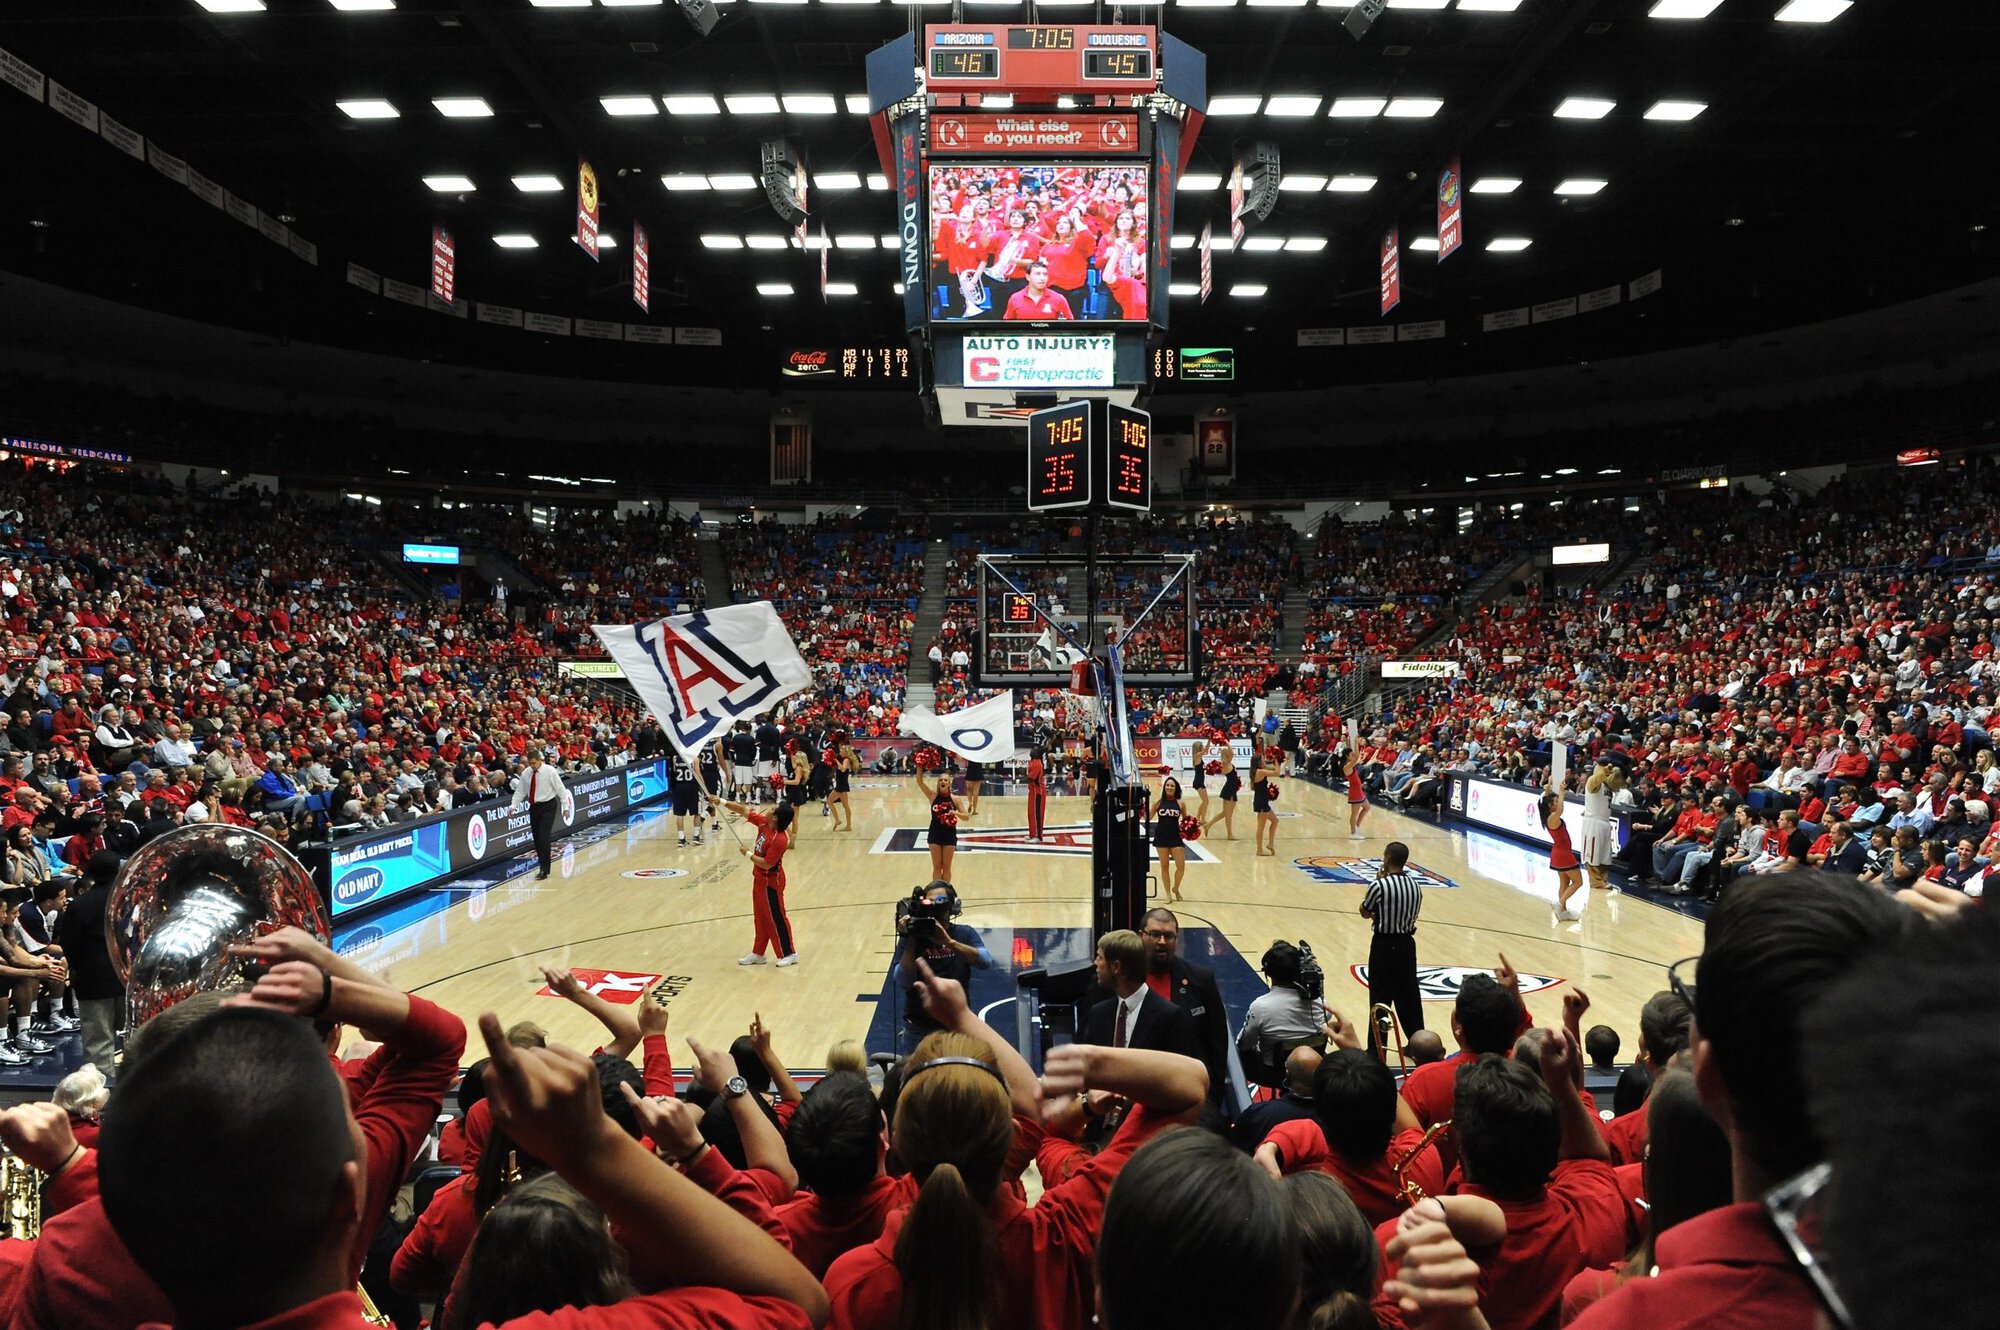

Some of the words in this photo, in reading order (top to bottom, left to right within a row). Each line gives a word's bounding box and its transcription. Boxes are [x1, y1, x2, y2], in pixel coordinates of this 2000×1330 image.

[944, 33, 985, 45] ARIZONA
[1026, 28, 1073, 48] 7:05
[1092, 34, 1144, 46] DUQUESNE
[954, 53, 982, 73] 46
[1108, 54, 1135, 74] 45
[996, 118, 1035, 132] What
[1039, 119, 1070, 132] else
[983, 131, 1003, 145] do
[1006, 133, 1033, 147] you
[1036, 131, 1083, 145] need?
[903, 201, 919, 285] DOWN
[966, 338, 1020, 350] AUTO
[1027, 338, 1111, 350] INJURY?
[1006, 357, 1036, 366] FIRST
[1004, 367, 1104, 382] Chiropractic
[1046, 416, 1083, 445] 7:05
[1121, 419, 1147, 448] 7:05
[12, 439, 64, 454] ARIZONA
[71, 447, 123, 462] WILDCATS
[1208, 443, 1223, 454] 22
[1042, 453, 1075, 494] 35
[1118, 454, 1142, 494] 35
[1011, 606, 1029, 619] 35
[574, 664, 617, 673] SUNSTREET
[1401, 662, 1446, 673] Fidelity
[700, 752, 713, 764] 22
[676, 769, 693, 781] 20
[486, 809, 497, 822] THE
[1158, 808, 1180, 817] CATS
[367, 845, 379, 856] OLD
[379, 841, 395, 855] NAVY
[338, 882, 356, 900] OLD
[357, 872, 379, 894] NAVY
